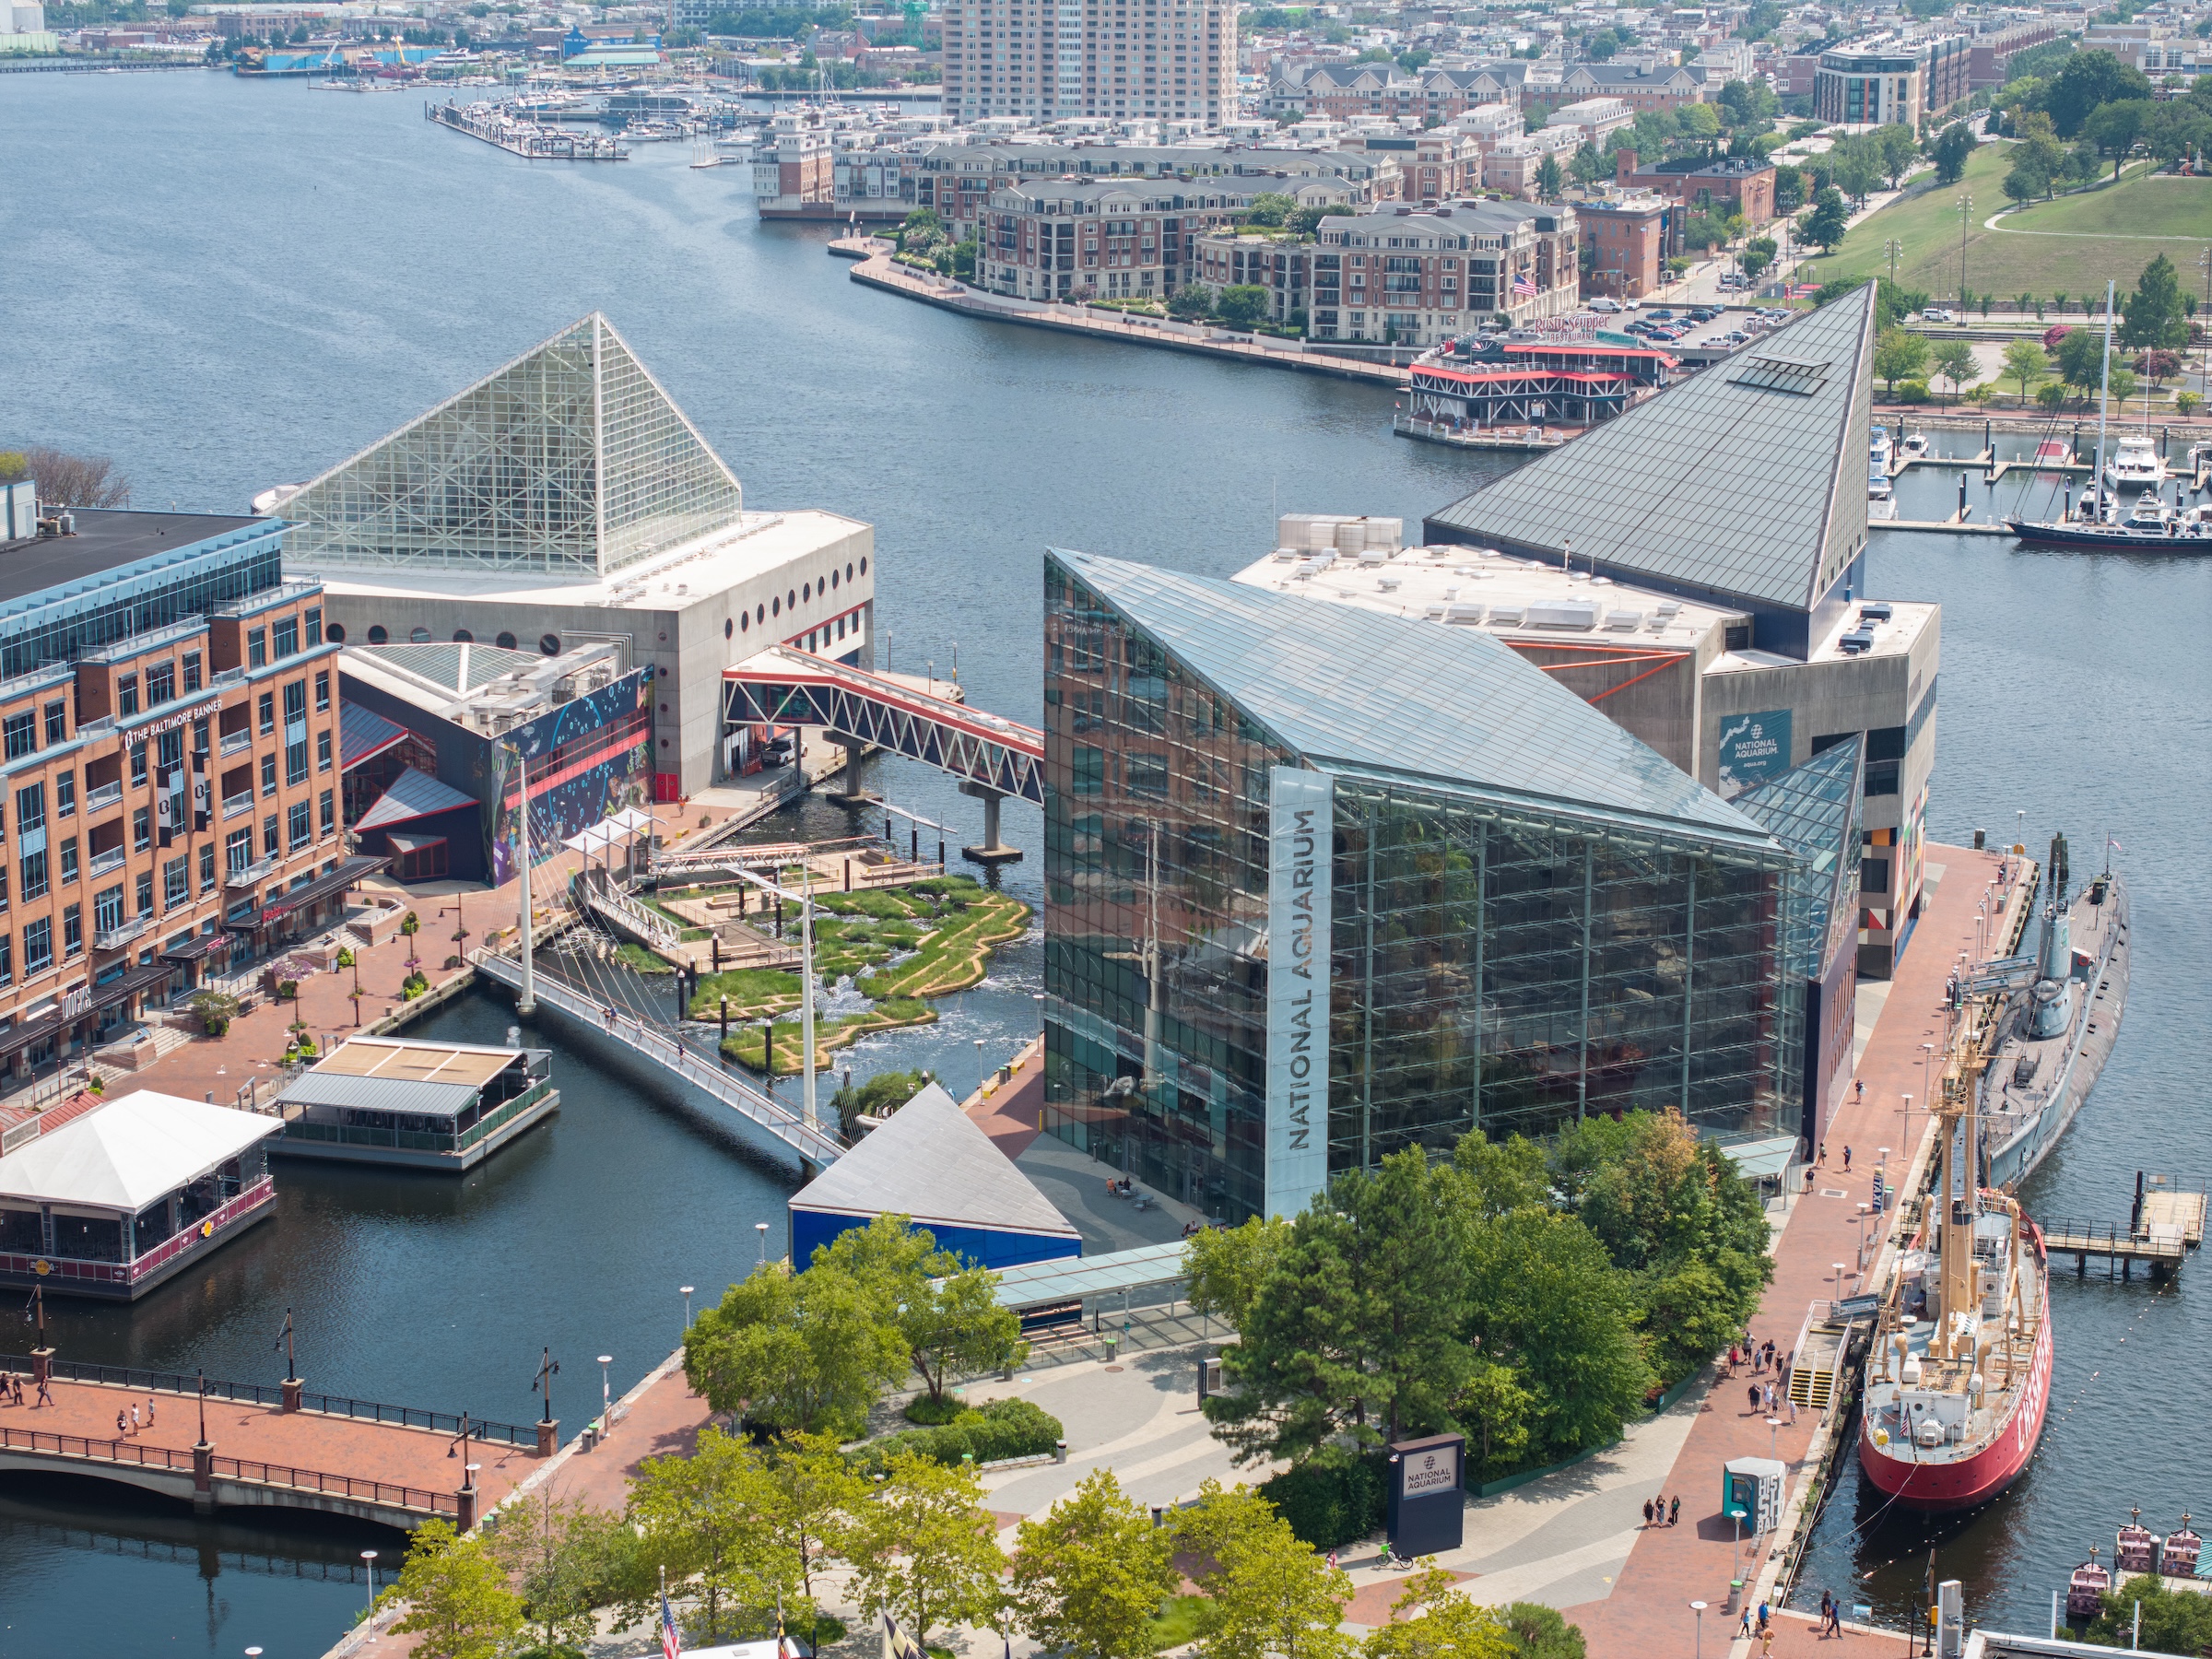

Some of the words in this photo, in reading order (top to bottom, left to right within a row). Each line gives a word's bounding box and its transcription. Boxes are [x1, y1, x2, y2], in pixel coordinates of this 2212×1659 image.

[1535, 317, 1566, 334] Rusty
[1568, 313, 1610, 333] Scupper
[1550, 332, 1595, 343] RESTAURANT
[133, 727, 148, 743] THE
[150, 711, 193, 736] BALTIMORE
[194, 699, 222, 720] BANNER
[1735, 738, 1777, 751] NATIONAL
[1735, 747, 1778, 759] AQUARIUM
[1291, 809, 1315, 981] AQUARIUM
[62, 984, 92, 1021] DOCKS
[1288, 989, 1312, 1151] NATIONAL
[1873, 1178, 1882, 1206] TAXI
[1407, 1467, 1451, 1483] NATIONAL
[1407, 1475, 1451, 1490] AQUARIUM
